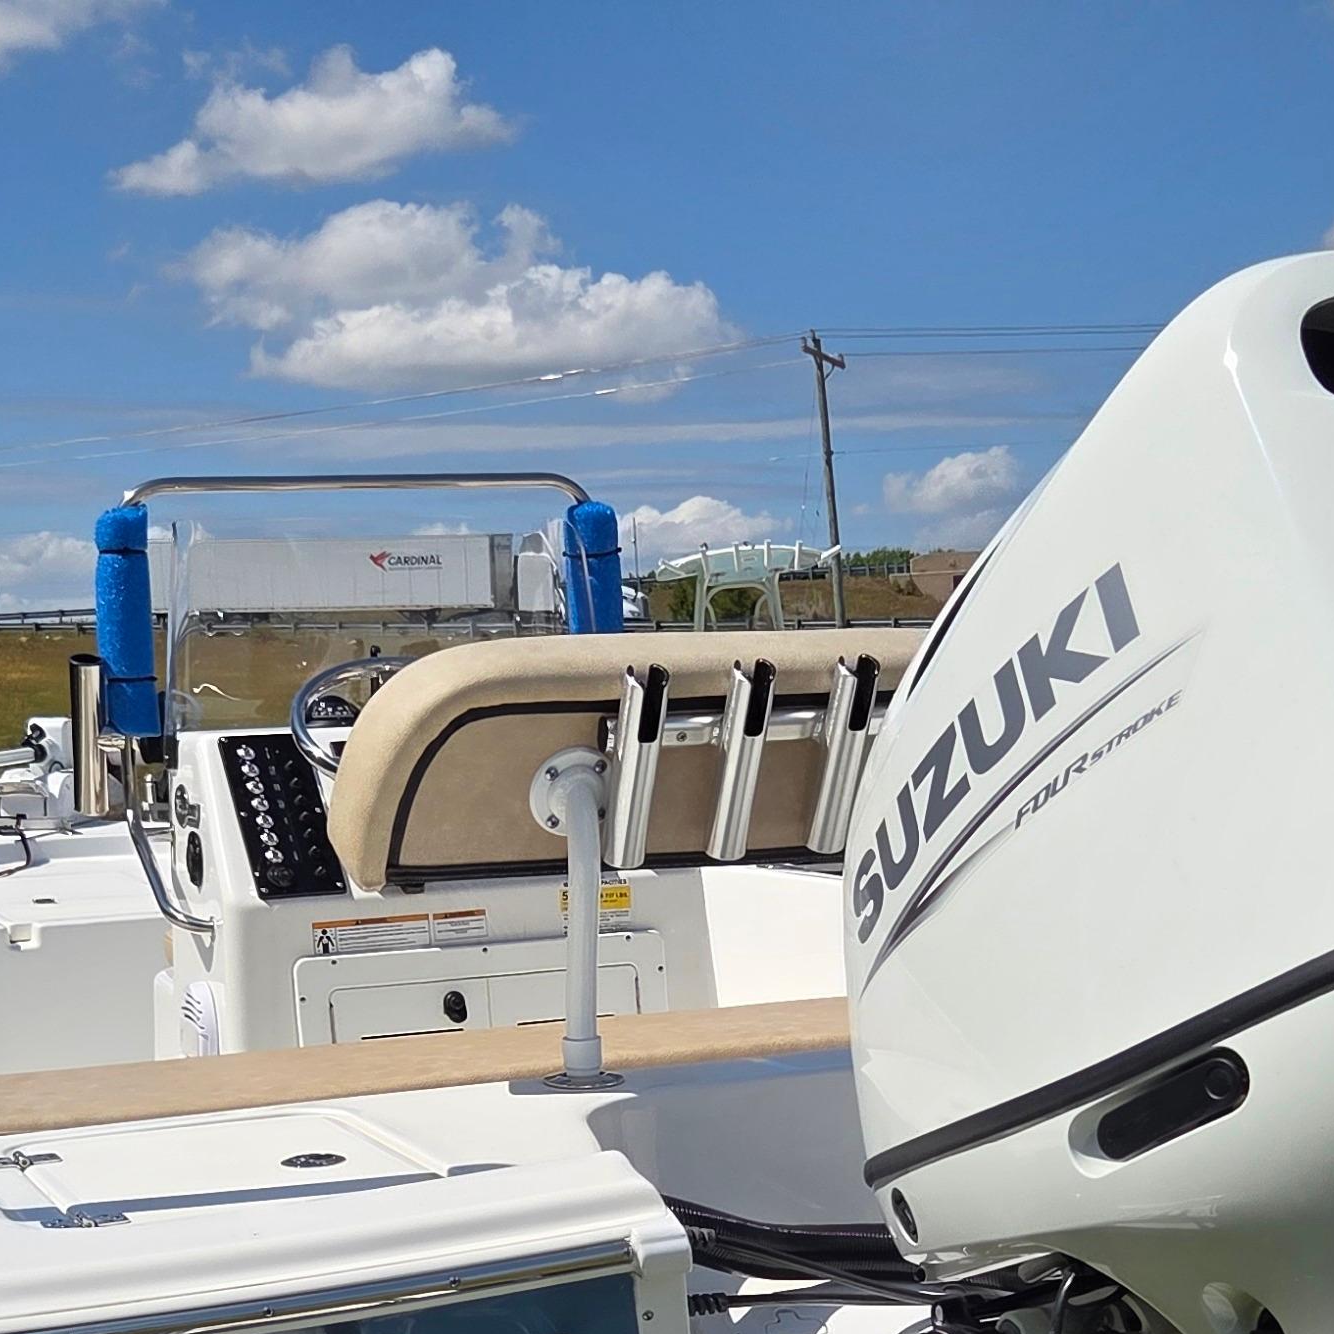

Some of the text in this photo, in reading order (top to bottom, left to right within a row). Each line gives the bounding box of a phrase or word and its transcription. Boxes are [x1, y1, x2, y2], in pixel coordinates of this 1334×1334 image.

[388, 554, 443, 566] CARDINAL
[853, 561, 1141, 945] SUZUKI
[1015, 689, 1183, 830] FOUR STROKE
